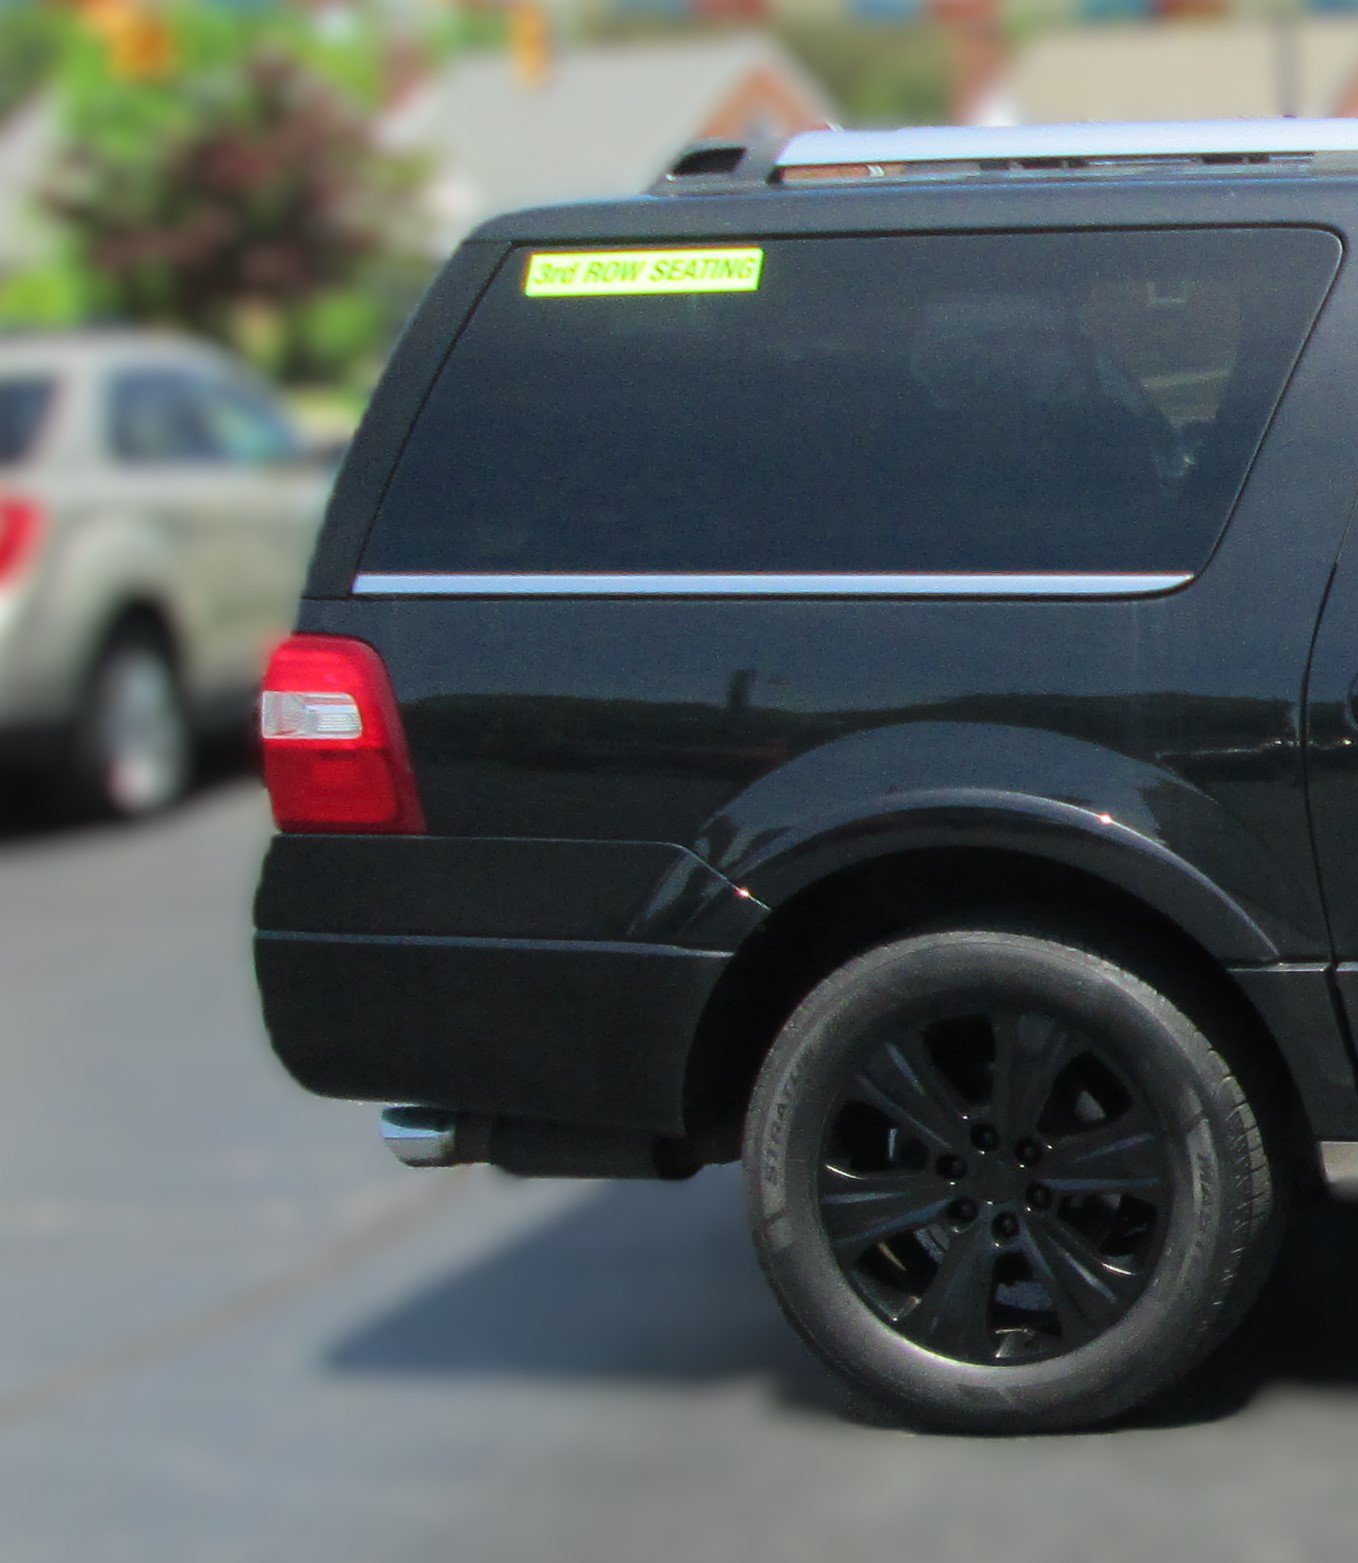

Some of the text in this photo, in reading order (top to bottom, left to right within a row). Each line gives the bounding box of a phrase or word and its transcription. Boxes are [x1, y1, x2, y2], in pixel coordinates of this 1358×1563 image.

[533, 256, 756, 285] 3rd ROW SEATING
